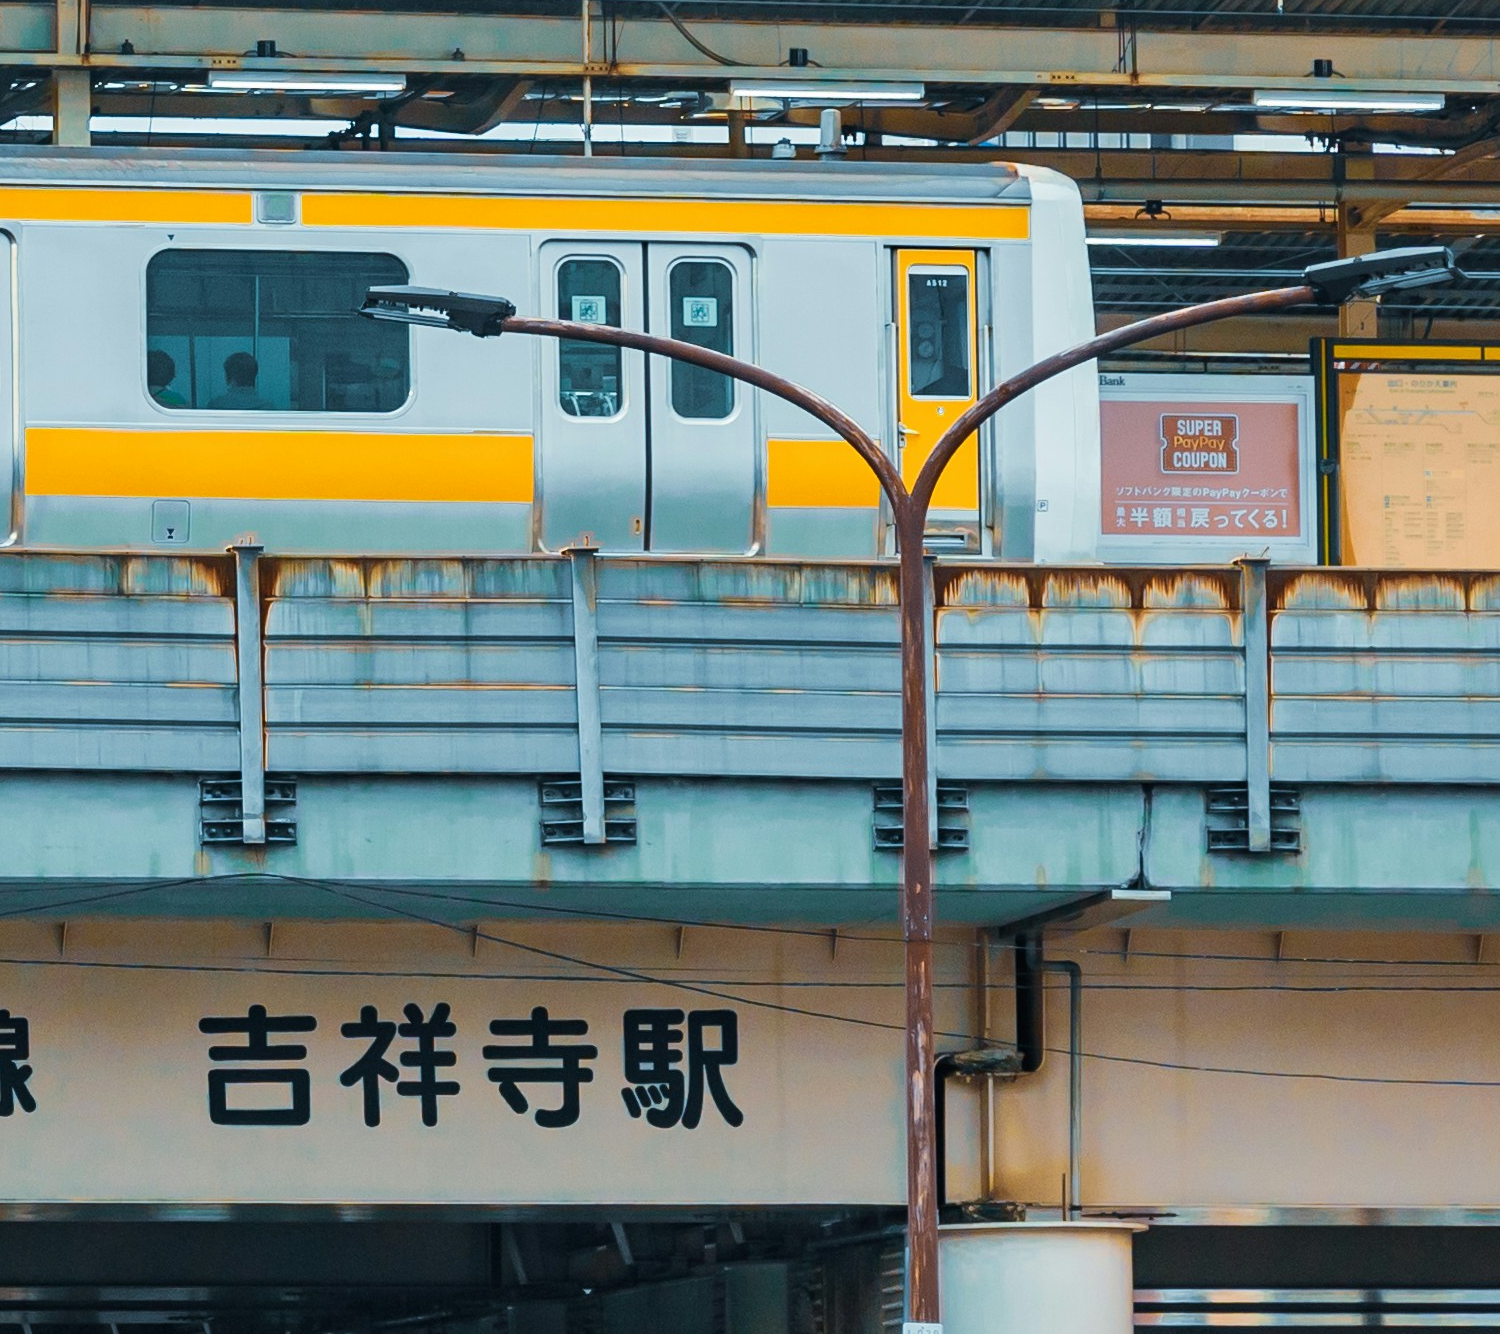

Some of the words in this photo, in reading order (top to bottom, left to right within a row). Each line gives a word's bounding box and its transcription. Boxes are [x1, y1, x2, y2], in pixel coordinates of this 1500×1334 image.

[926, 279, 948, 287] A512
[1177, 419, 1223, 436] SUPER
[1174, 436, 1225, 451] PayPay
[1173, 452, 1227, 468] COUPON
[198, 1003, 744, 1130] 吉祥寺駅
